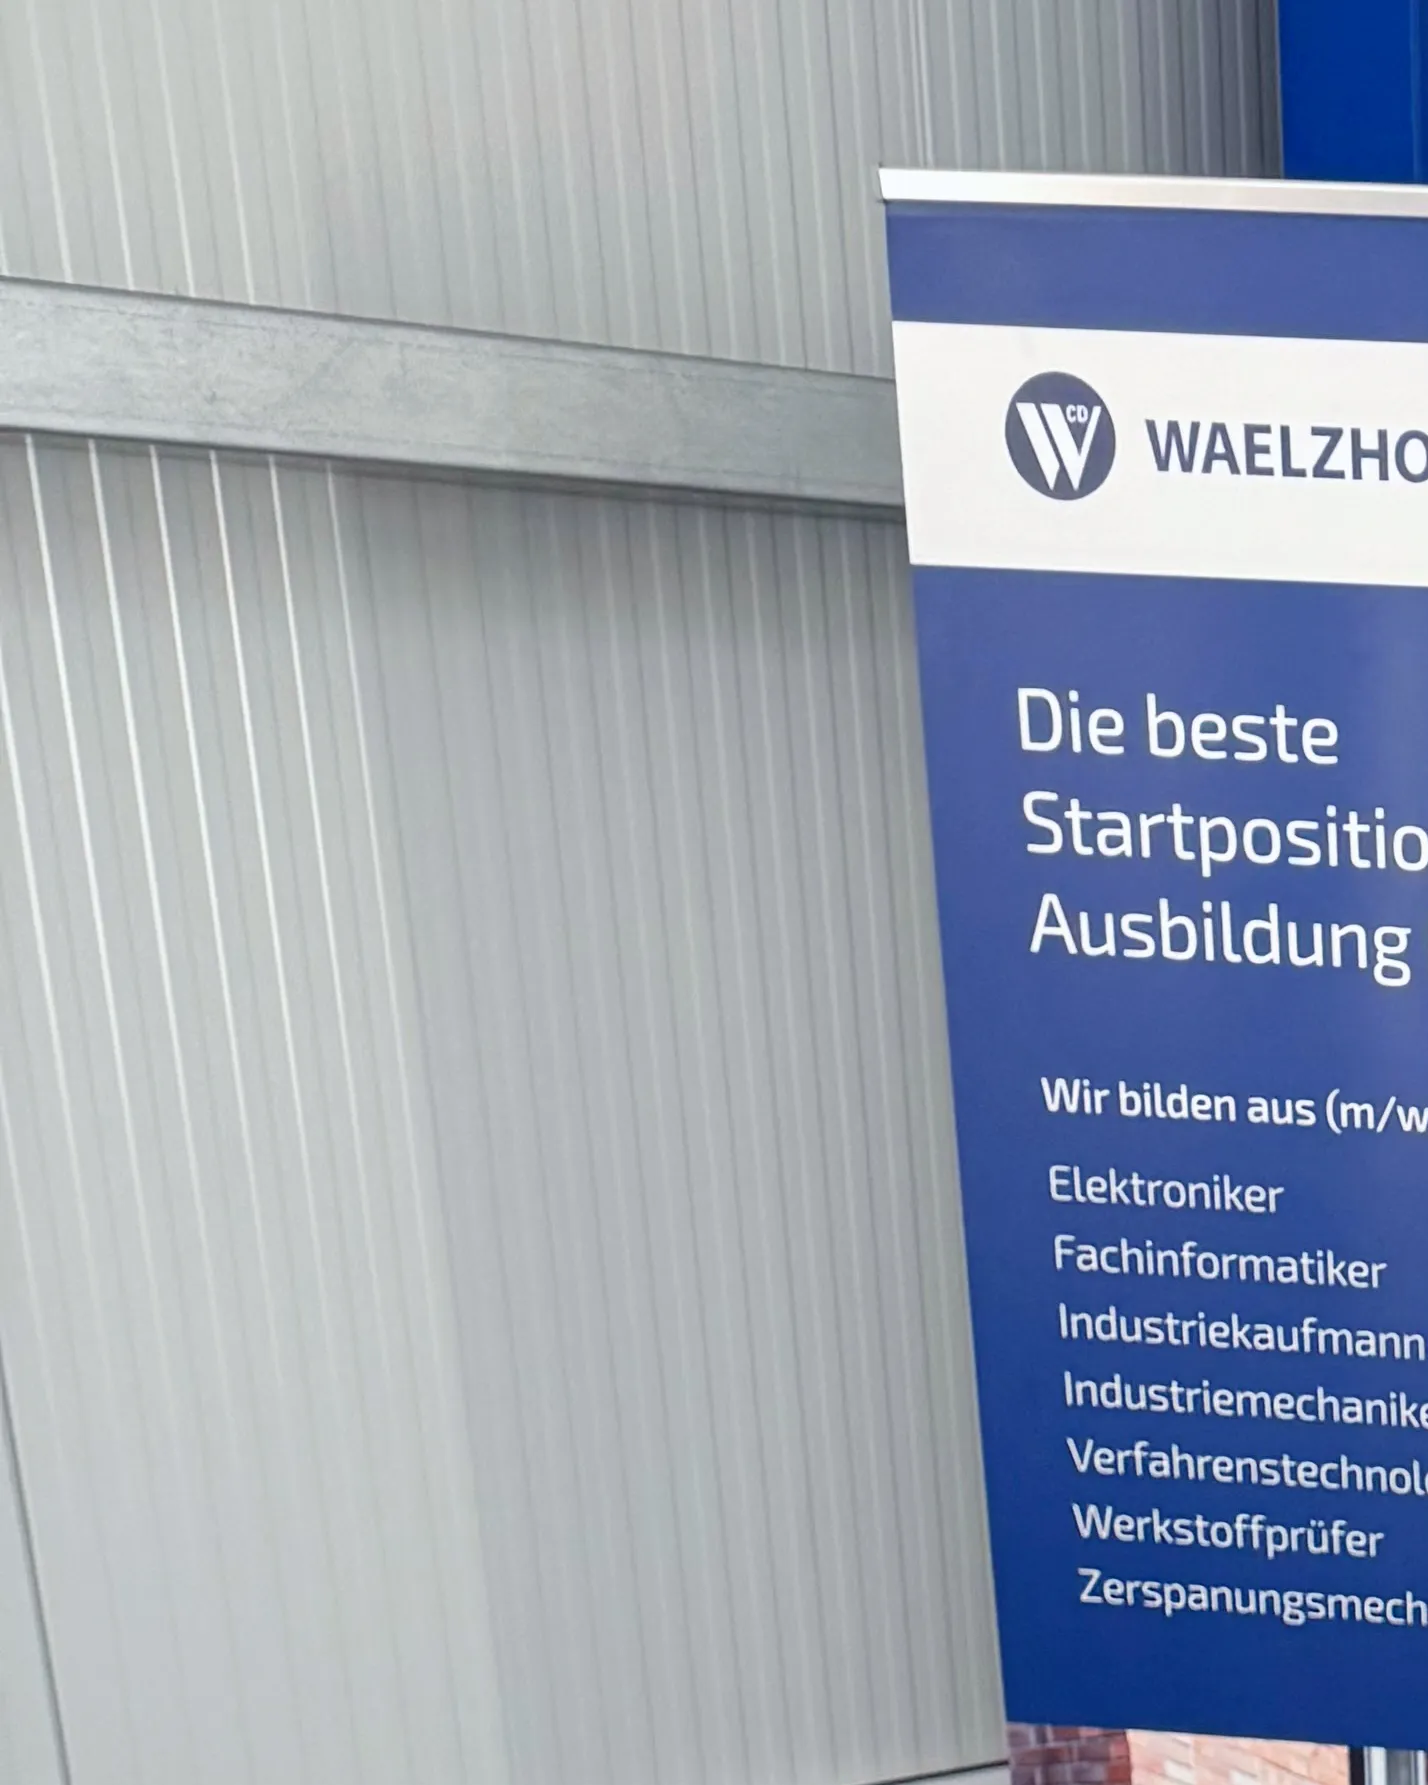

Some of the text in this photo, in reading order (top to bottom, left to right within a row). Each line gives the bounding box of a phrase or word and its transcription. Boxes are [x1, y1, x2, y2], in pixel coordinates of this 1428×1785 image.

[1018, 688, 1338, 764] Die beste
[1031, 894, 1411, 986] Ausbildung
[1041, 1077, 1110, 1114] Wir
[1119, 1081, 1236, 1121] bilden
[1248, 1097, 1316, 1125] aus
[1050, 1165, 1284, 1212] Elektroniker
[1055, 1235, 1387, 1288] Fachinformatiker
[1060, 1303, 1425, 1360] Industriekaufmann
[1073, 1504, 1384, 1559] Werkstoffprüfer
